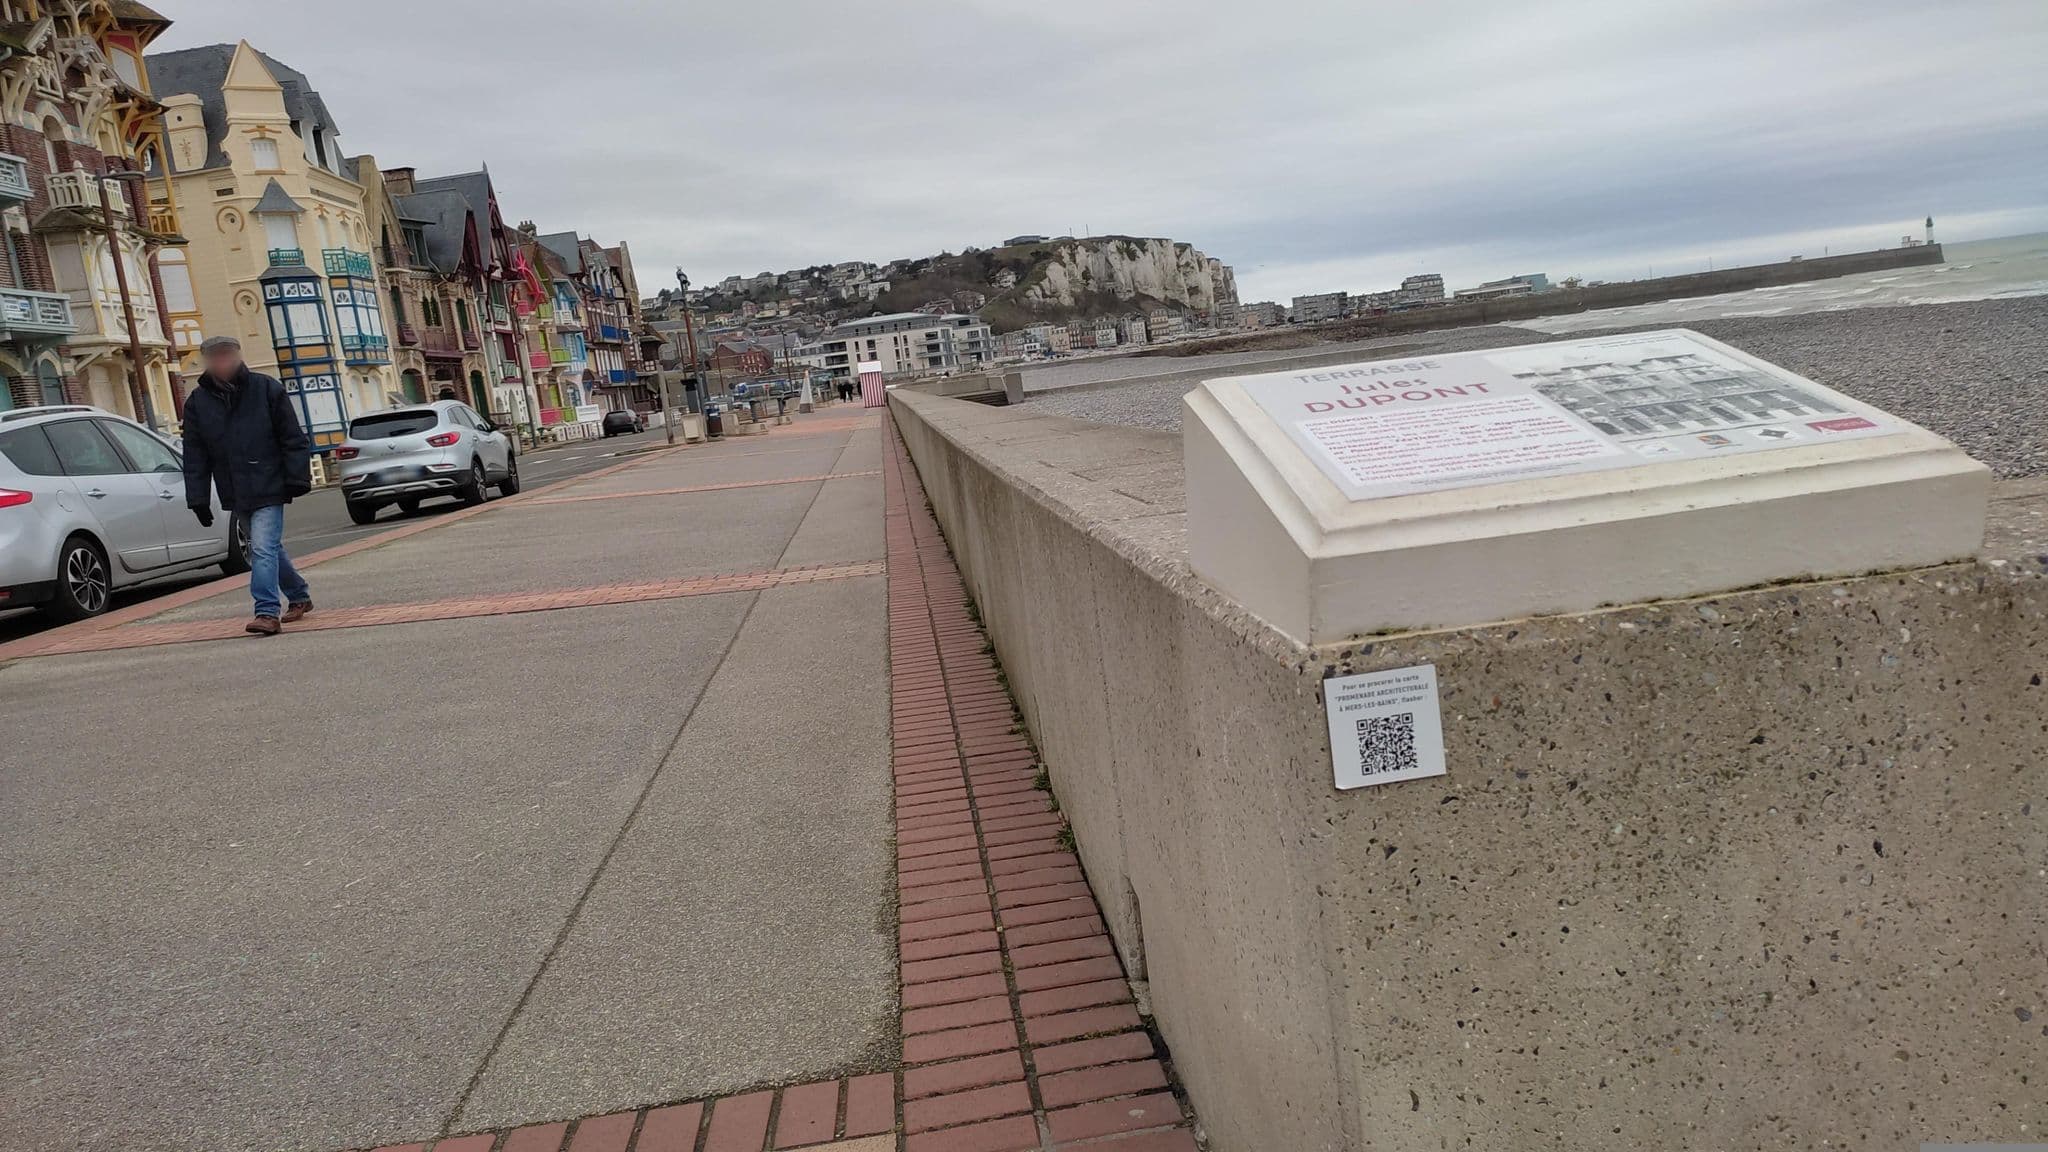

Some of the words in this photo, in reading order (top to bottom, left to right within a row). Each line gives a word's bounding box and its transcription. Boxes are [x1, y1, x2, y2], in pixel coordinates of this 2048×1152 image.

[1294, 360, 1441, 384] TERRASSE
[1339, 378, 1428, 394] Jules
[1304, 382, 1490, 413] DUPONT
[1367, 678, 1394, 688] procurer
[1376, 682, 1428, 696] ARCHITECTURALE
